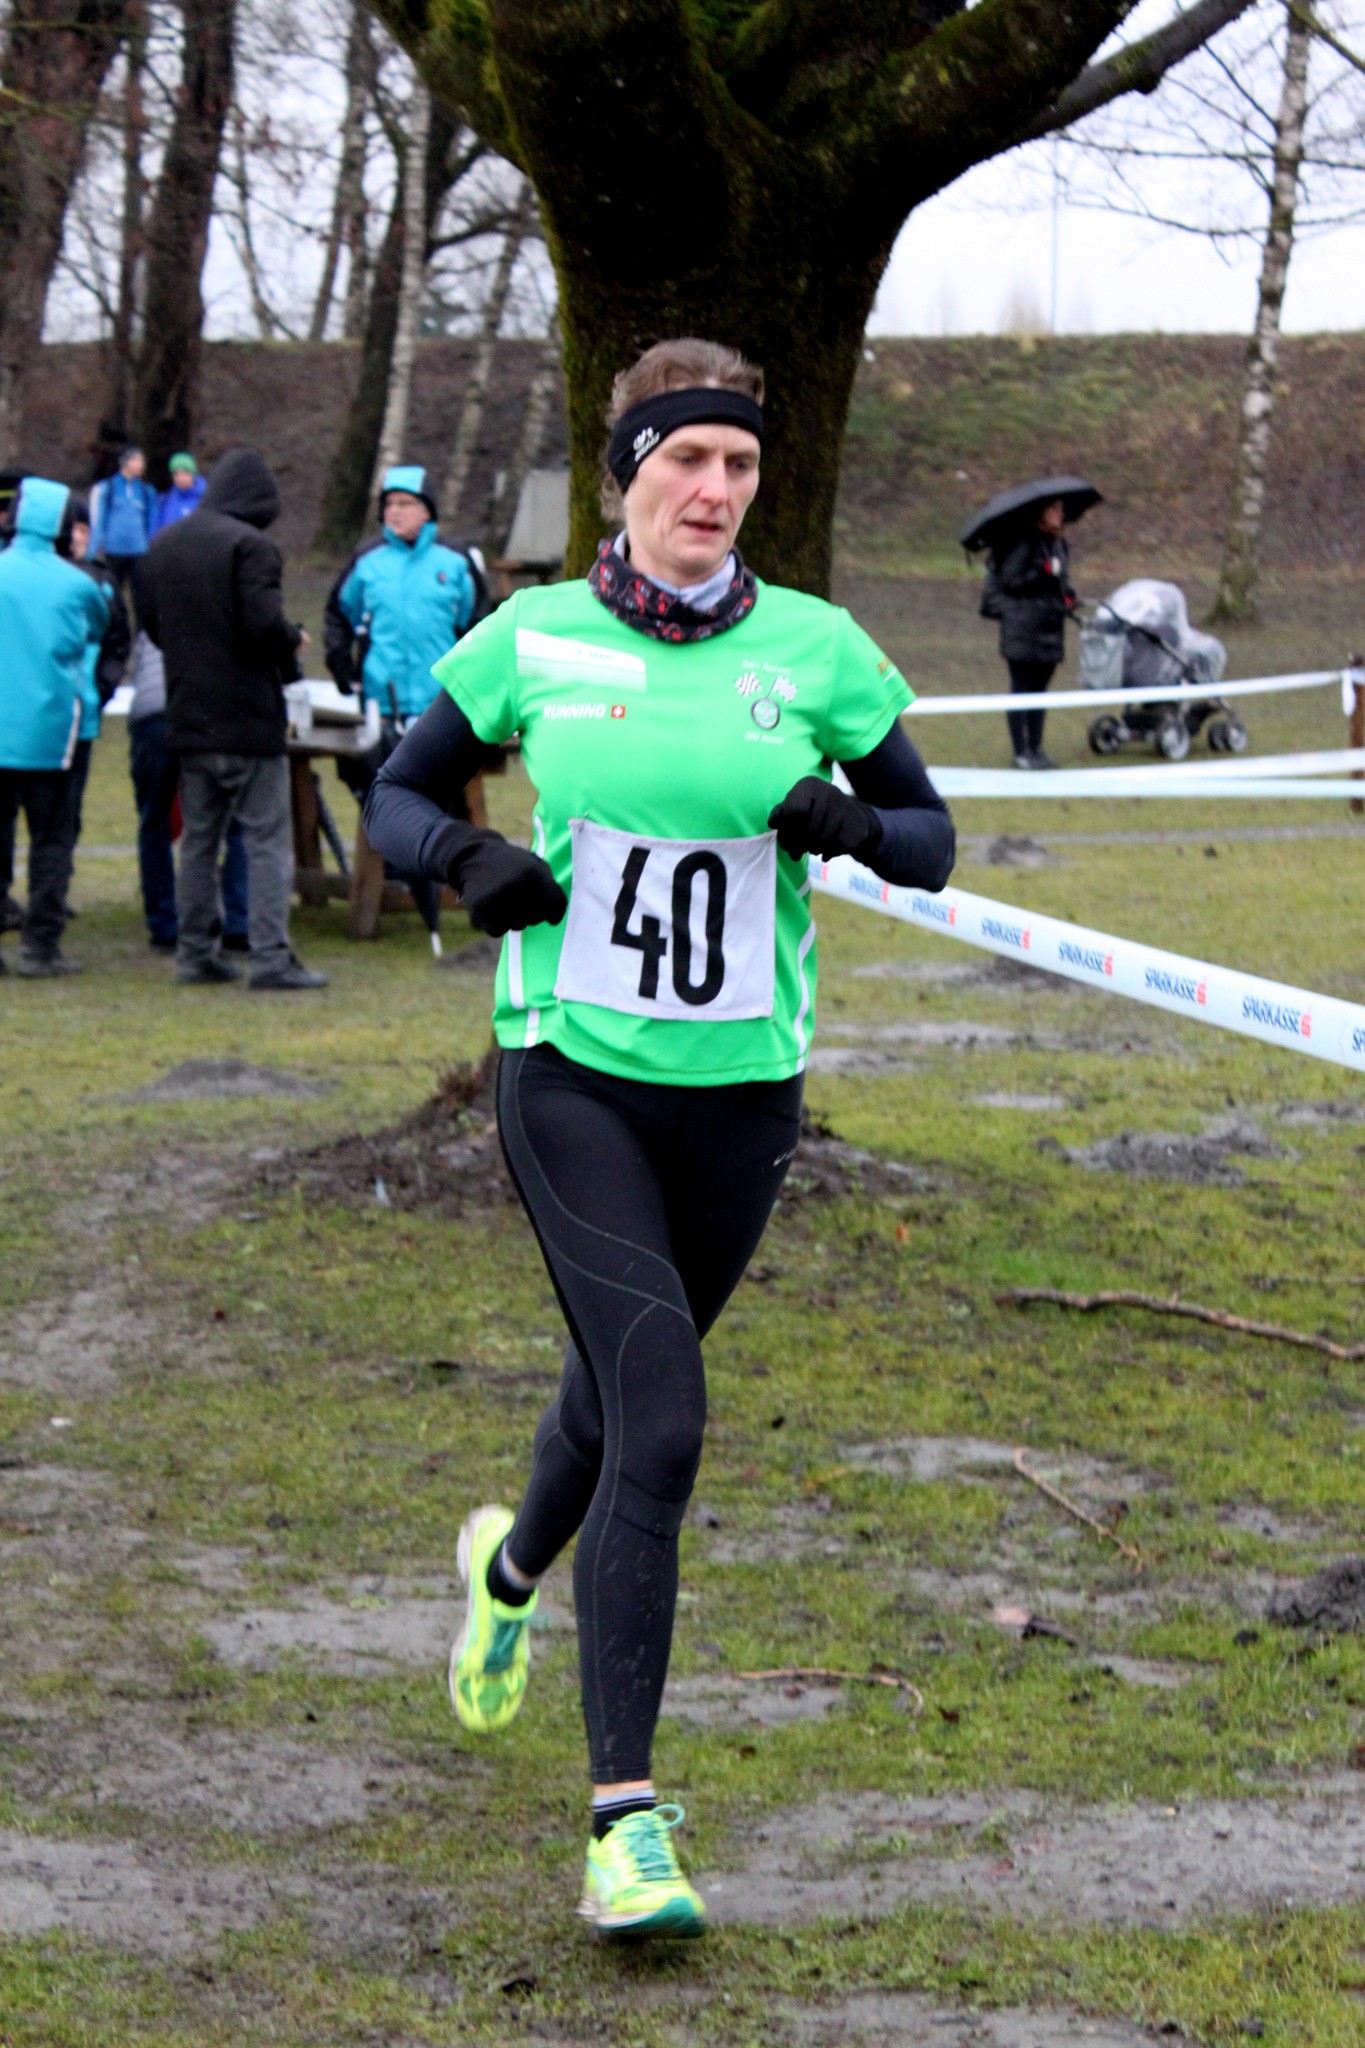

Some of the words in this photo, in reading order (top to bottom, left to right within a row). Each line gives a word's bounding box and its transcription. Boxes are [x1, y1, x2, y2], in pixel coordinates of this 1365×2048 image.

[543, 703, 606, 720] RUNNING
[611, 846, 727, 1006] 40
[1057, 940, 1104, 974] SPARKASSE
[1144, 966, 1197, 1003] SPARKASSE
[1241, 994, 1301, 1035] SPARKASSE
